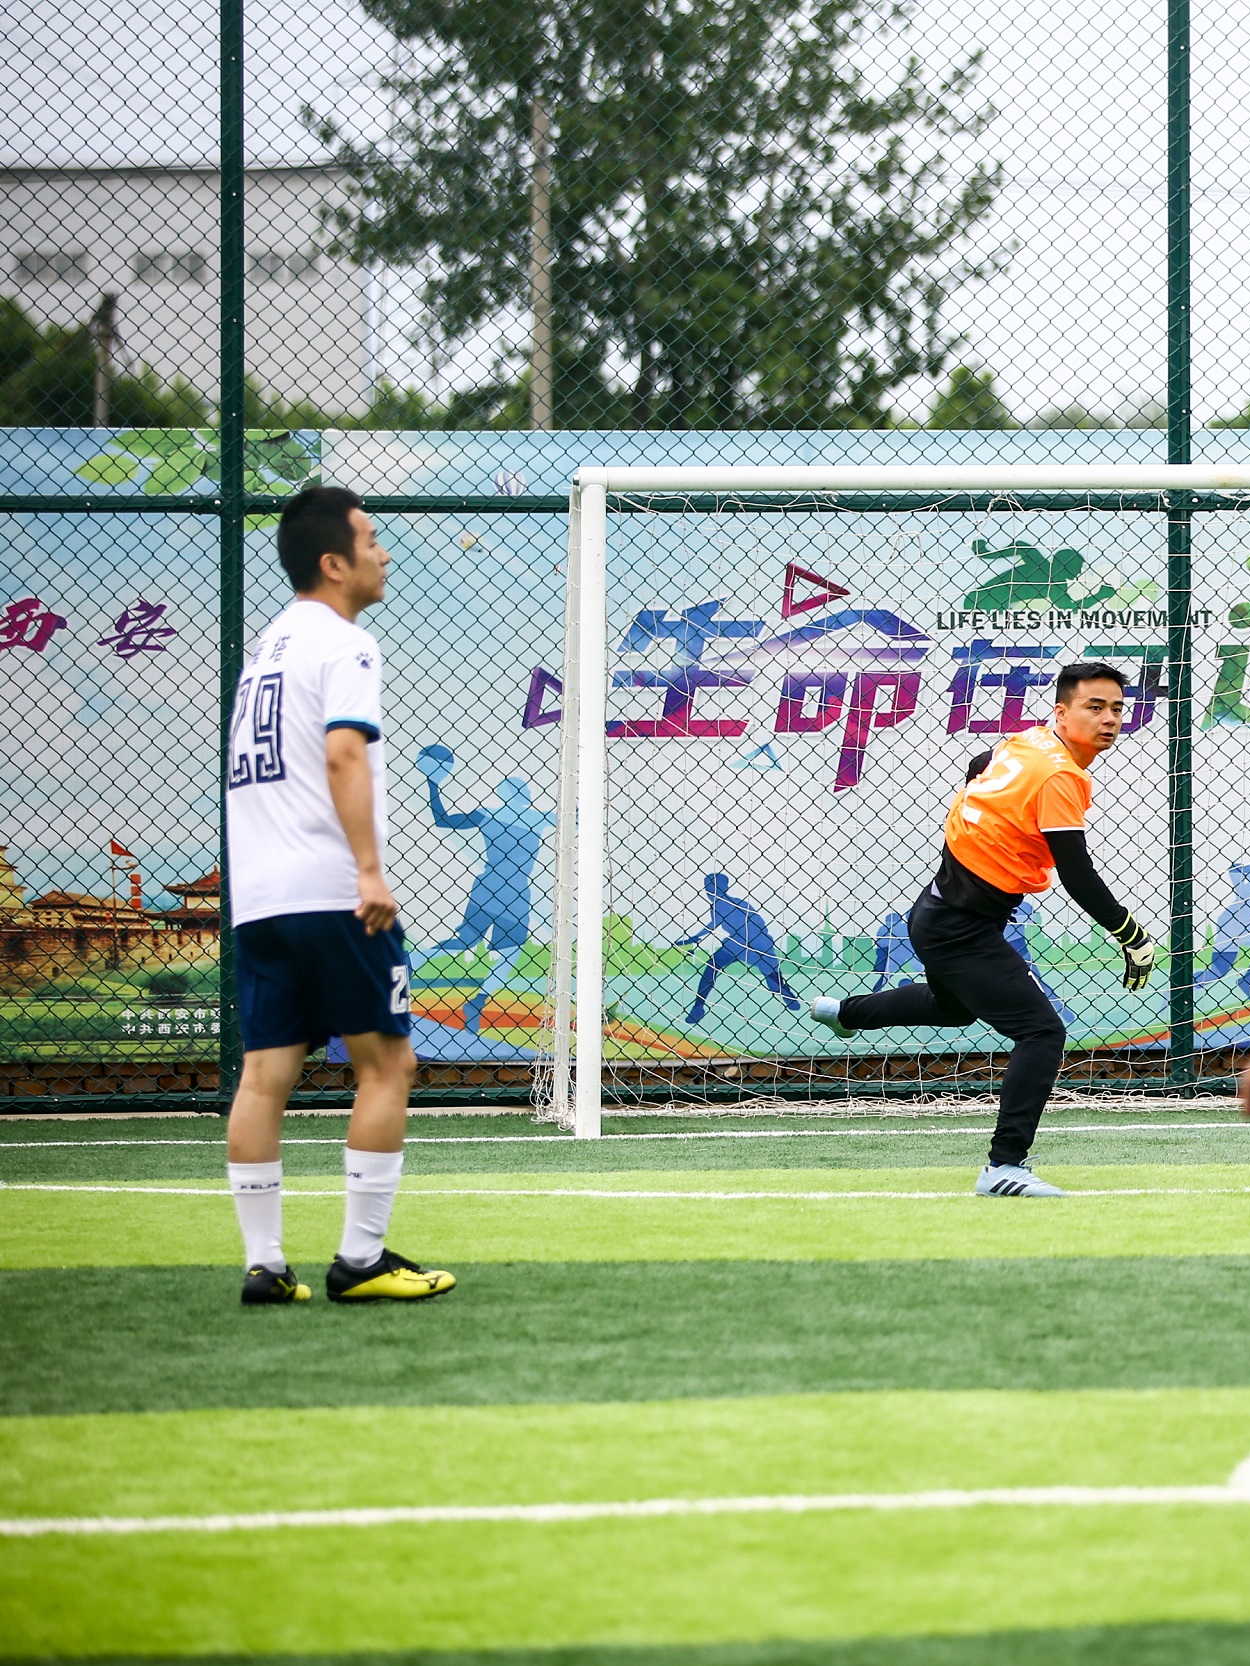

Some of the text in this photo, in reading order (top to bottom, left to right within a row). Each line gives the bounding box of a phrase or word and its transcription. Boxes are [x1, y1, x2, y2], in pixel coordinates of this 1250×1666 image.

[937, 609, 1213, 630] LIFE LIES IN MOVEMNT
[228, 671, 286, 790] 29
[390, 965, 412, 1014] 2
